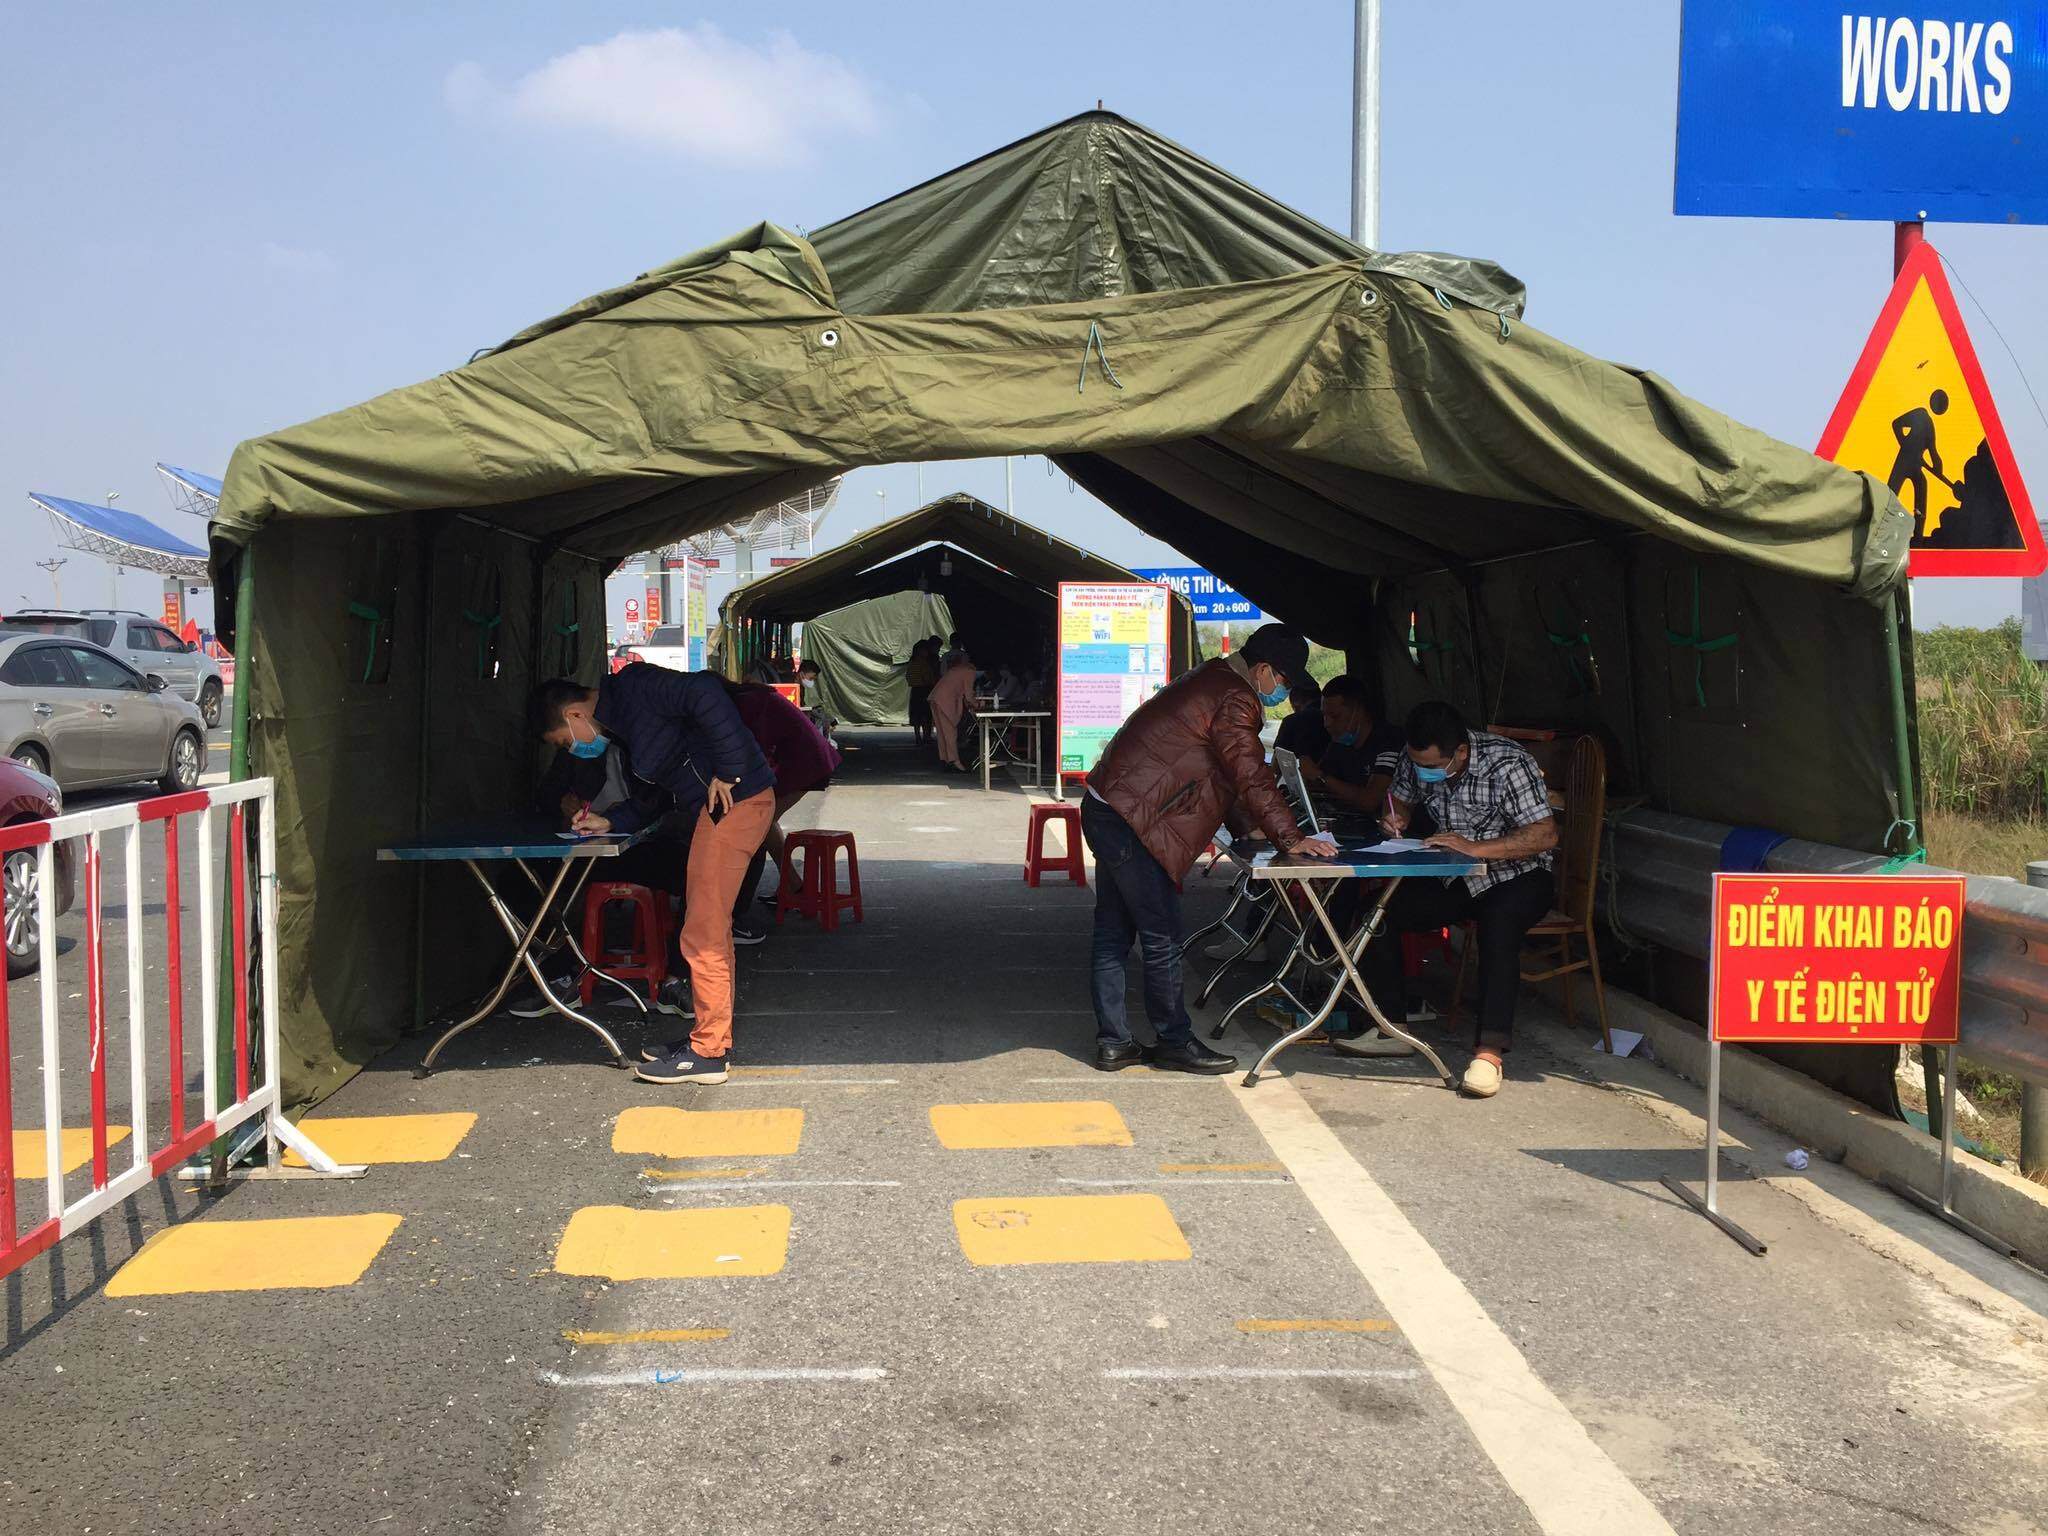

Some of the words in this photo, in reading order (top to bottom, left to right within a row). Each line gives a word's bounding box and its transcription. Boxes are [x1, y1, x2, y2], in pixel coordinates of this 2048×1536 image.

[1841, 14, 2014, 115] WORKS
[1191, 575, 1214, 594] THI
[1193, 603, 1208, 614] km
[1727, 886, 1805, 948] ĐIỂM
[1814, 904, 1885, 949] KHAI
[1893, 896, 1954, 949] BÁO
[1746, 979, 1766, 1023] Y
[1773, 966, 1810, 1023] TẾ
[1815, 971, 1886, 1034] ĐIỆN
[1895, 966, 1936, 1025] TỬ
